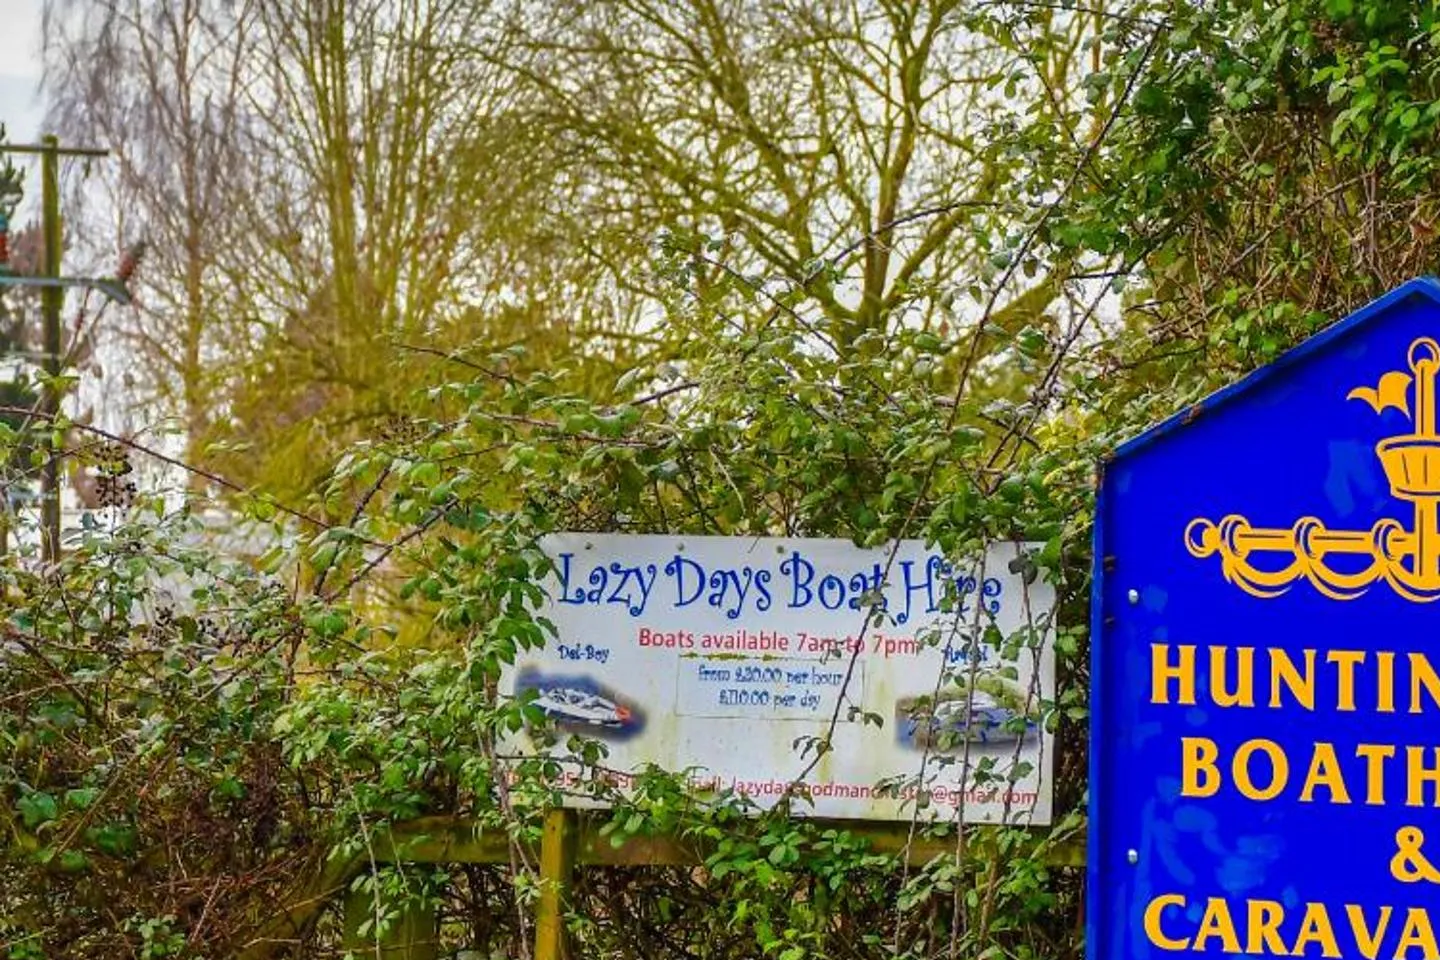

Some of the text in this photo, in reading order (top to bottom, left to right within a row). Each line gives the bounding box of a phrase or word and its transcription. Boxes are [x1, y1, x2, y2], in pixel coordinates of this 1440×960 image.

[558, 552, 658, 617] Lazy
[664, 554, 773, 619] Days
[779, 551, 889, 611] Boat
[638, 627, 695, 648] Boats
[702, 630, 789, 651] available
[797, 632, 839, 652] 7am
[845, 635, 867, 653] to
[872, 634, 916, 659] 7pm
[698, 664, 731, 682] from
[786, 671, 809, 687] per
[811, 666, 844, 686] hour
[774, 693, 796, 711] per
[800, 689, 821, 711] day
